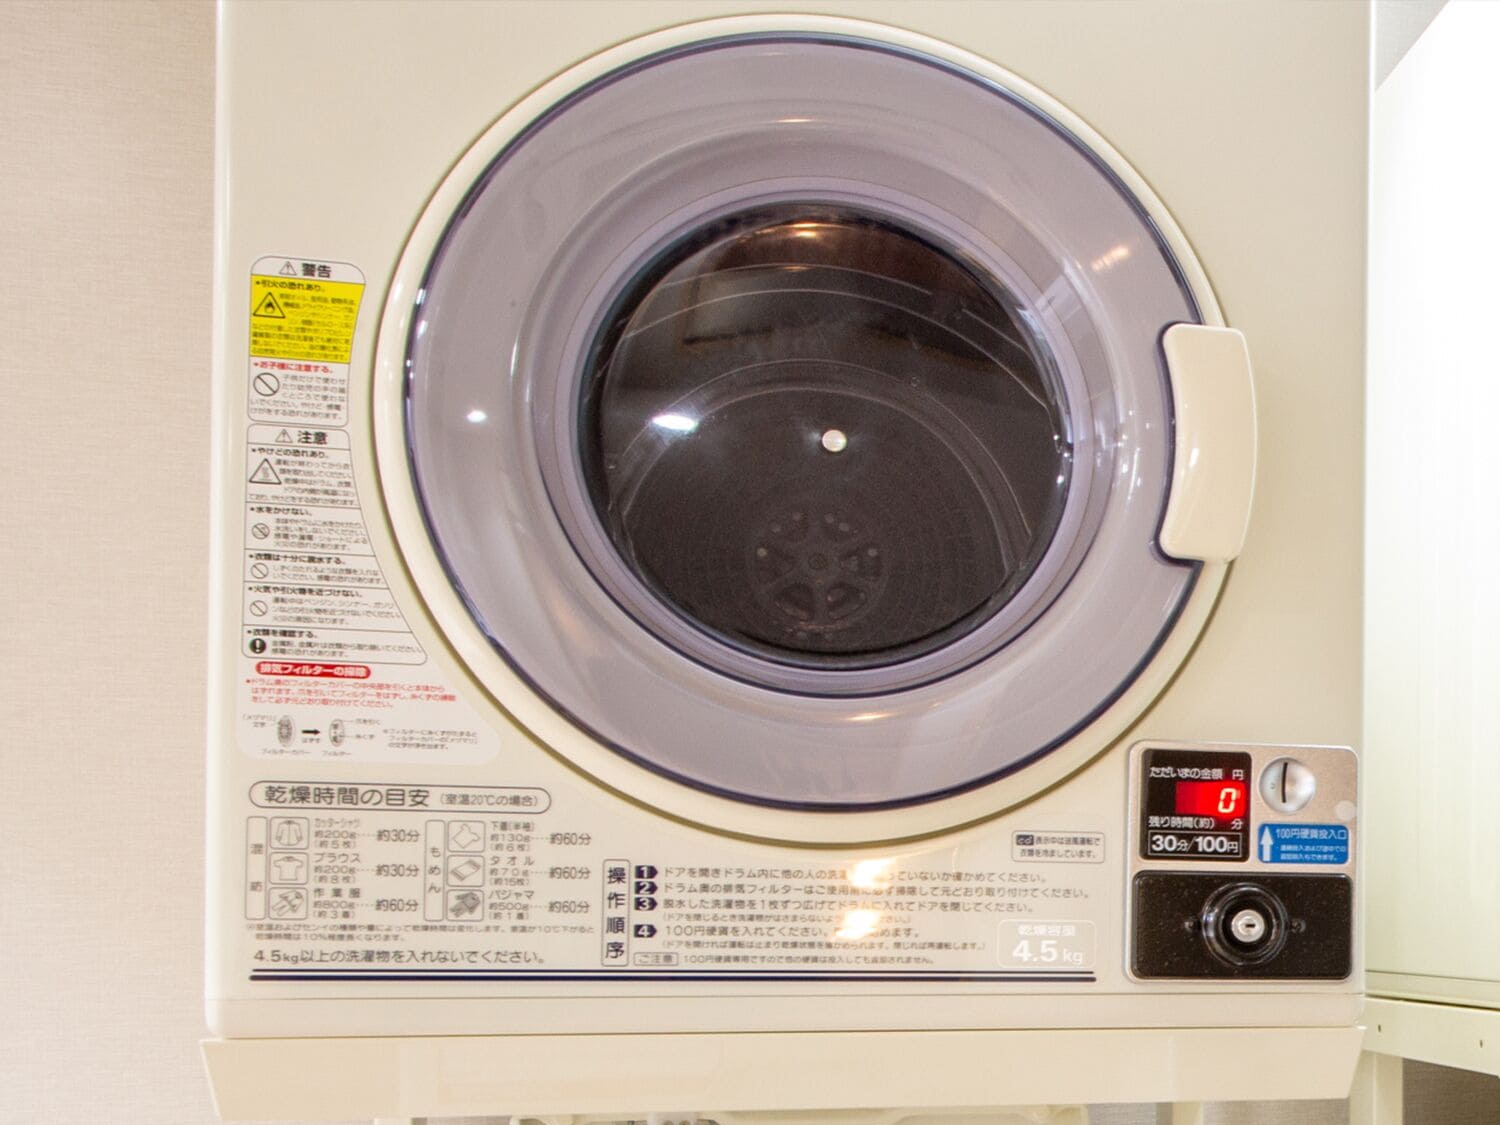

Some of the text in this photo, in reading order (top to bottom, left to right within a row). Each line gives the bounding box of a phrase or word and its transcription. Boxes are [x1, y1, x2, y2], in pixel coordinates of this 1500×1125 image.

[302, 263, 331, 279] 警告
[260, 280, 325, 292] 引火の恐れあり。
[259, 361, 334, 374] お子様に注意する。
[298, 431, 328, 445] 注意
[258, 447, 329, 458] やけどの恐れあり。
[256, 507, 312, 516] 水をかけない。
[255, 554, 346, 564] 衣類は十分に脱水する。
[254, 586, 363, 598] 火気や引火物を近づけない。
[253, 629, 317, 638] 衣類を確認する。
[1150, 767, 1244, 780] ただいまの金額 円
[265, 785, 429, 807] 乾燥時間の目安
[1219, 788, 1237, 813] 0
[1148, 816, 1243, 830] 残り時間(約) 分
[377, 830, 419, 842] 約30分
[550, 833, 591, 845] 約60分
[1276, 828, 1346, 839] 100円硬貨投入口
[1151, 835, 1238, 853] 30分/100円
[315, 853, 360, 863] ブラウス
[490, 856, 534, 866] タオル
[376, 865, 418, 877] 約30分
[428, 847, 440, 894] もめん
[550, 867, 590, 879] 約60分
[314, 888, 360, 898] 作業服
[638, 883, 648, 894] 2
[489, 890, 534, 900] パジャマ
[375, 899, 418, 911] 約60分
[549, 902, 590, 913] 約60分
[638, 899, 648, 910] 3
[606, 867, 626, 960] 操作順序
[637, 926, 649, 937] 4
[254, 950, 544, 964] 4.5kg以上の洗濯物を入れないでください。
[1013, 941, 1083, 965] 4.5 kg
[640, 955, 673, 964] ご注意
